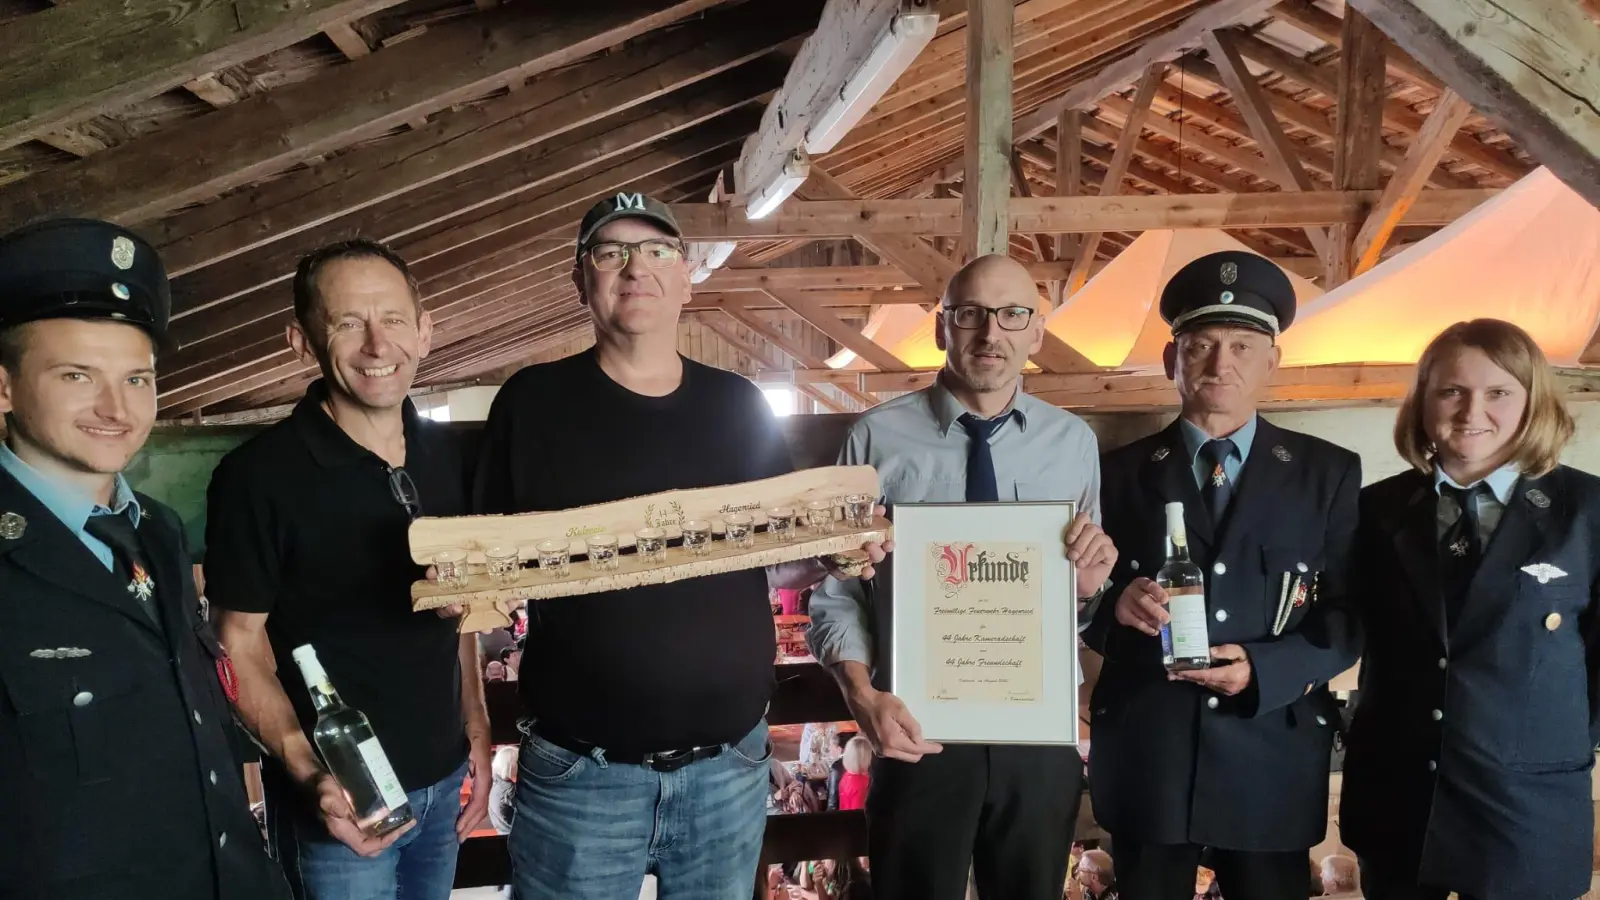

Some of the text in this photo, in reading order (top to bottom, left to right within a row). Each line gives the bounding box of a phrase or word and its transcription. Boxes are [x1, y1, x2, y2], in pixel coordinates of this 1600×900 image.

[614, 192, 646, 211] M
[719, 501, 761, 514] Hagenried
[935, 542, 1031, 588] Urkunde
[933, 607, 1034, 615] Freiwillige Feuerwehr Hagenried
[953, 634, 972, 644] Jahre
[974, 634, 1026, 644] Kameradschaft
[957, 658, 975, 668] Jahre
[977, 658, 1023, 668] Freundschaft
